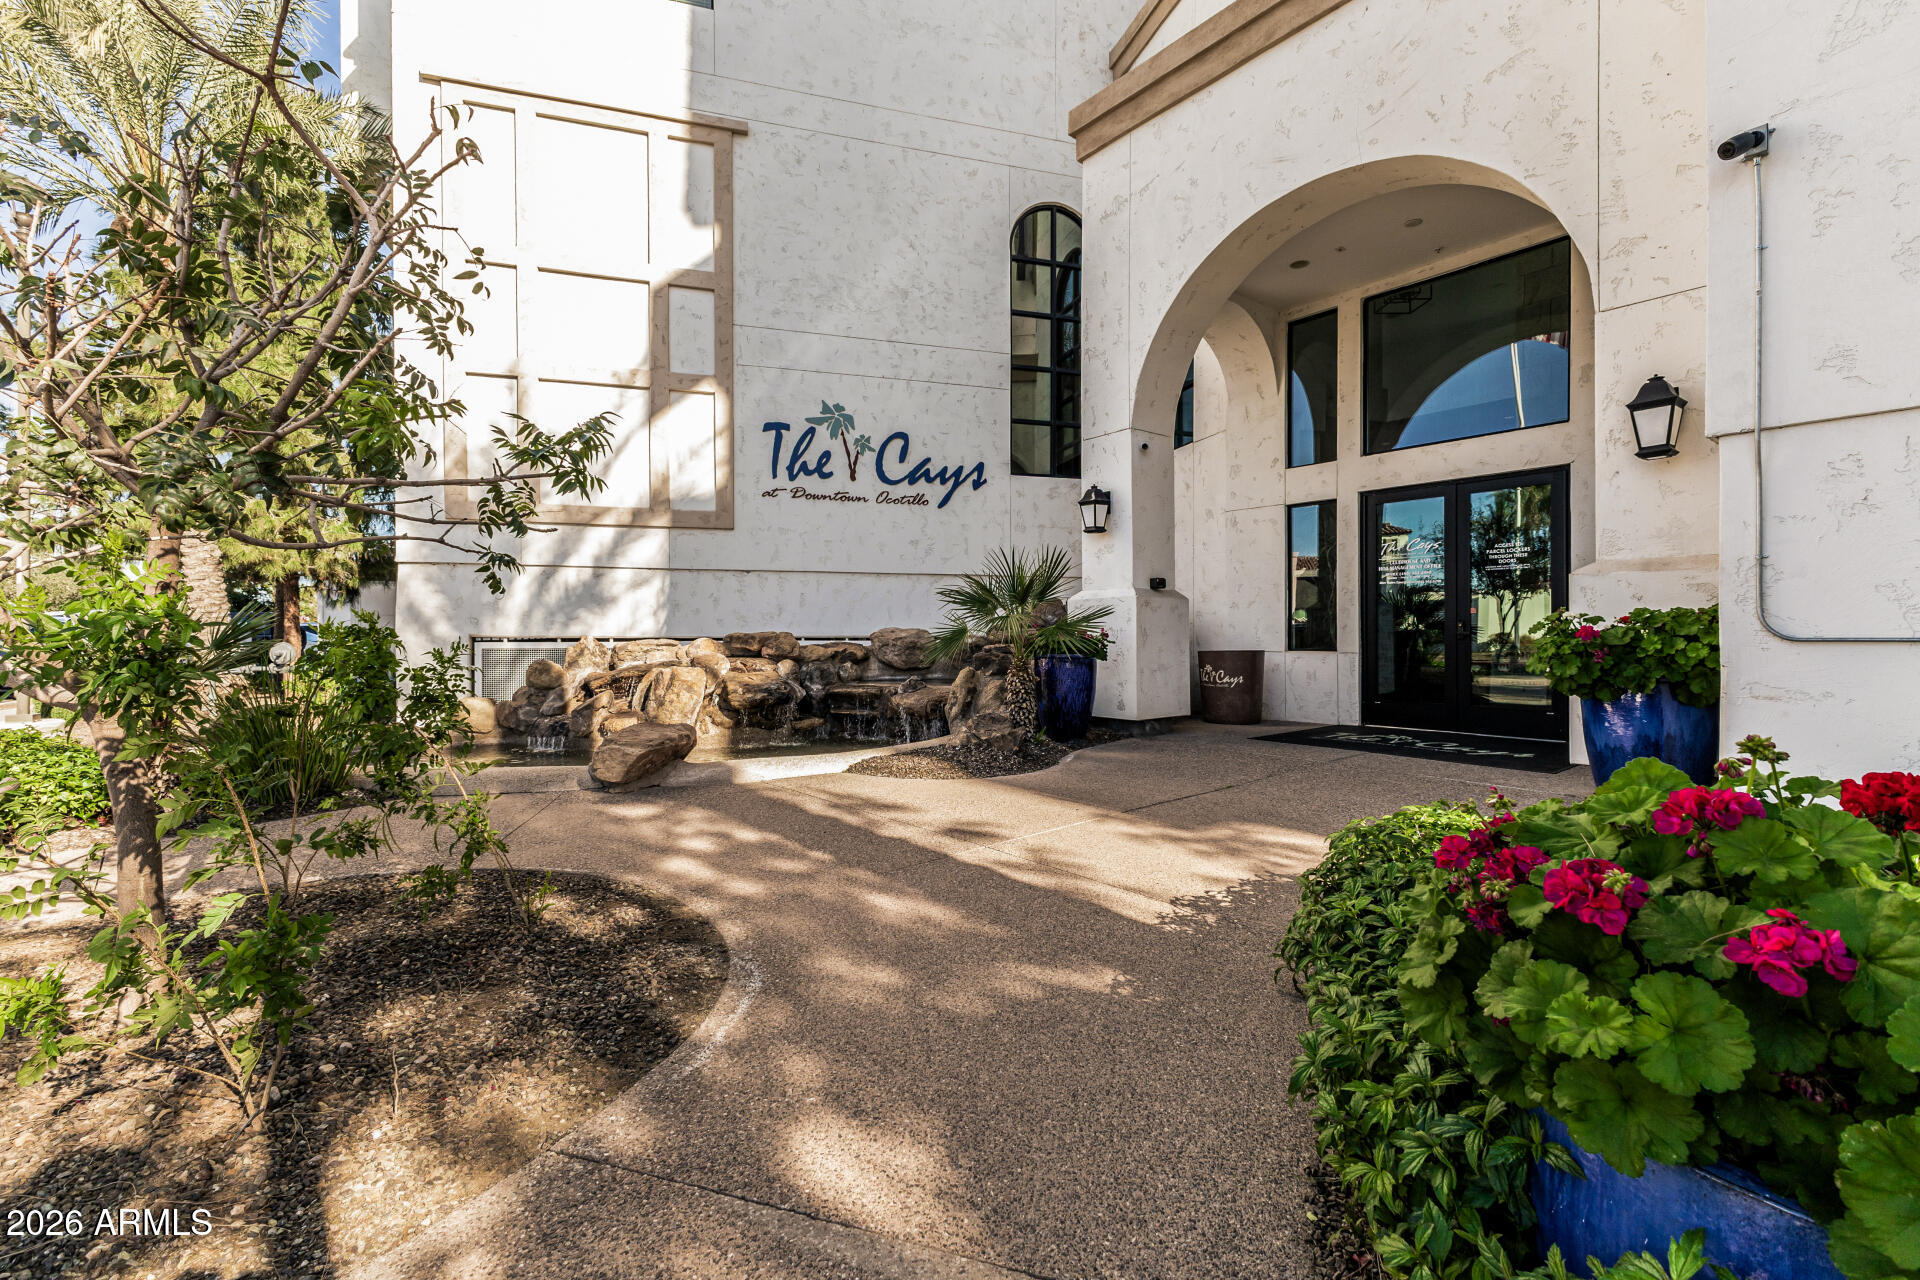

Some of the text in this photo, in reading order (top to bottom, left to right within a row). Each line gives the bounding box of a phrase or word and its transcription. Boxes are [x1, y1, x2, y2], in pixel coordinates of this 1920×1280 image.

[762, 421, 988, 509] The Cays
[761, 486, 930, 506] at Downtown Ocotillo
[1380, 537, 1442, 556] The Cays
[1215, 669, 1244, 688] Cays
